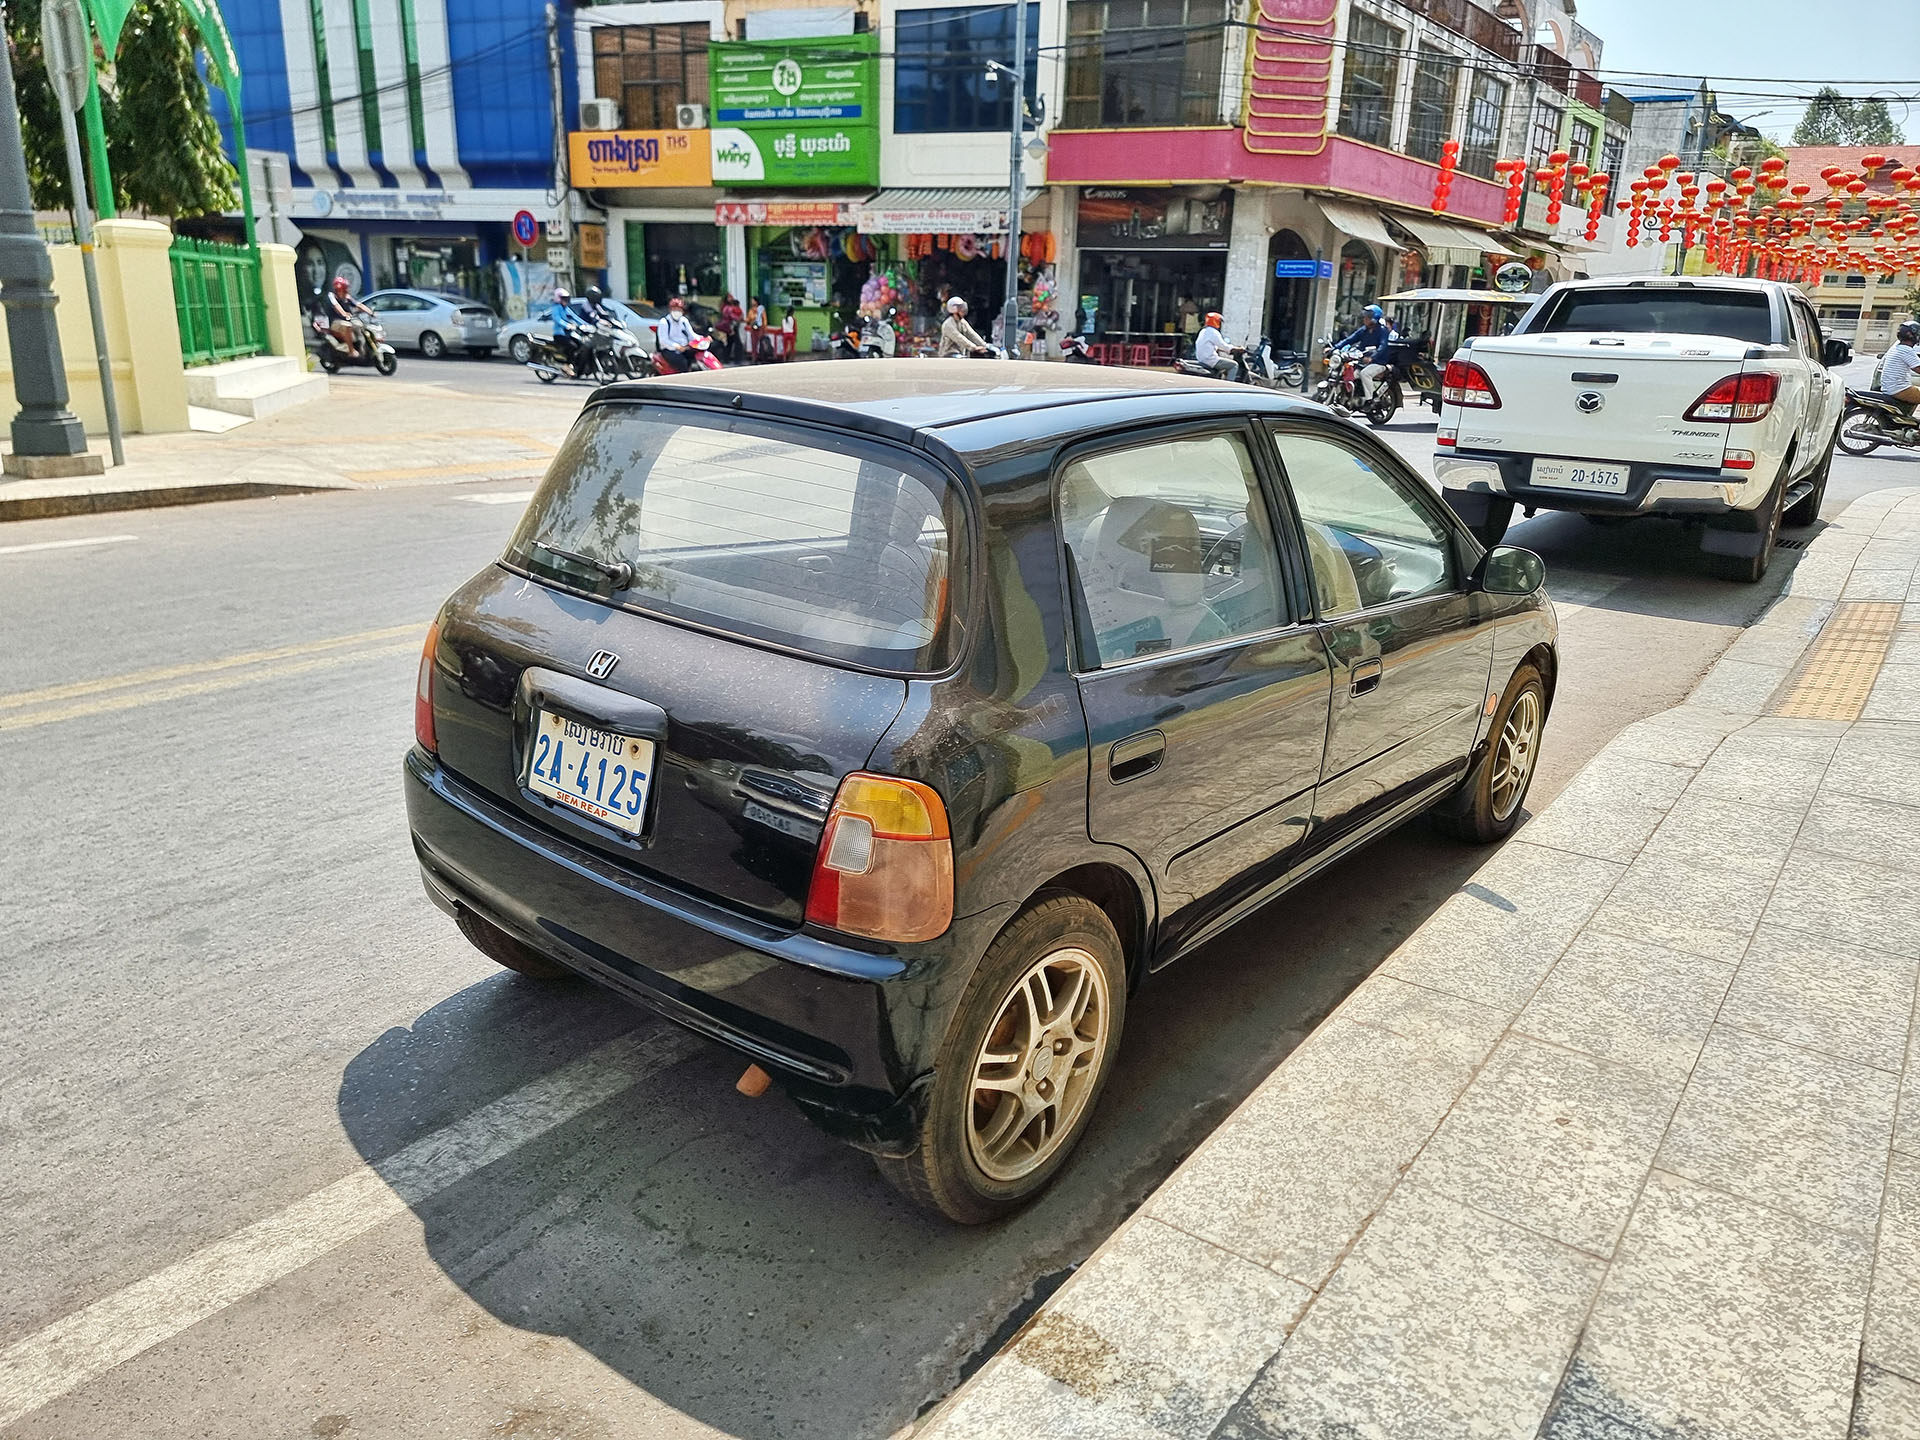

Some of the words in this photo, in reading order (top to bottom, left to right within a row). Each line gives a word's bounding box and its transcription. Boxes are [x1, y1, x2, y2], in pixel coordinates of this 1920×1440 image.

[666, 135, 688, 149] THS
[716, 149, 752, 169] Wing
[1671, 429, 1720, 439] THUNDER
[1570, 468, 1620, 485] 2D-1575
[533, 734, 647, 816] 2A-4125
[556, 791, 579, 808] SIEM
[580, 802, 609, 818] REAP
